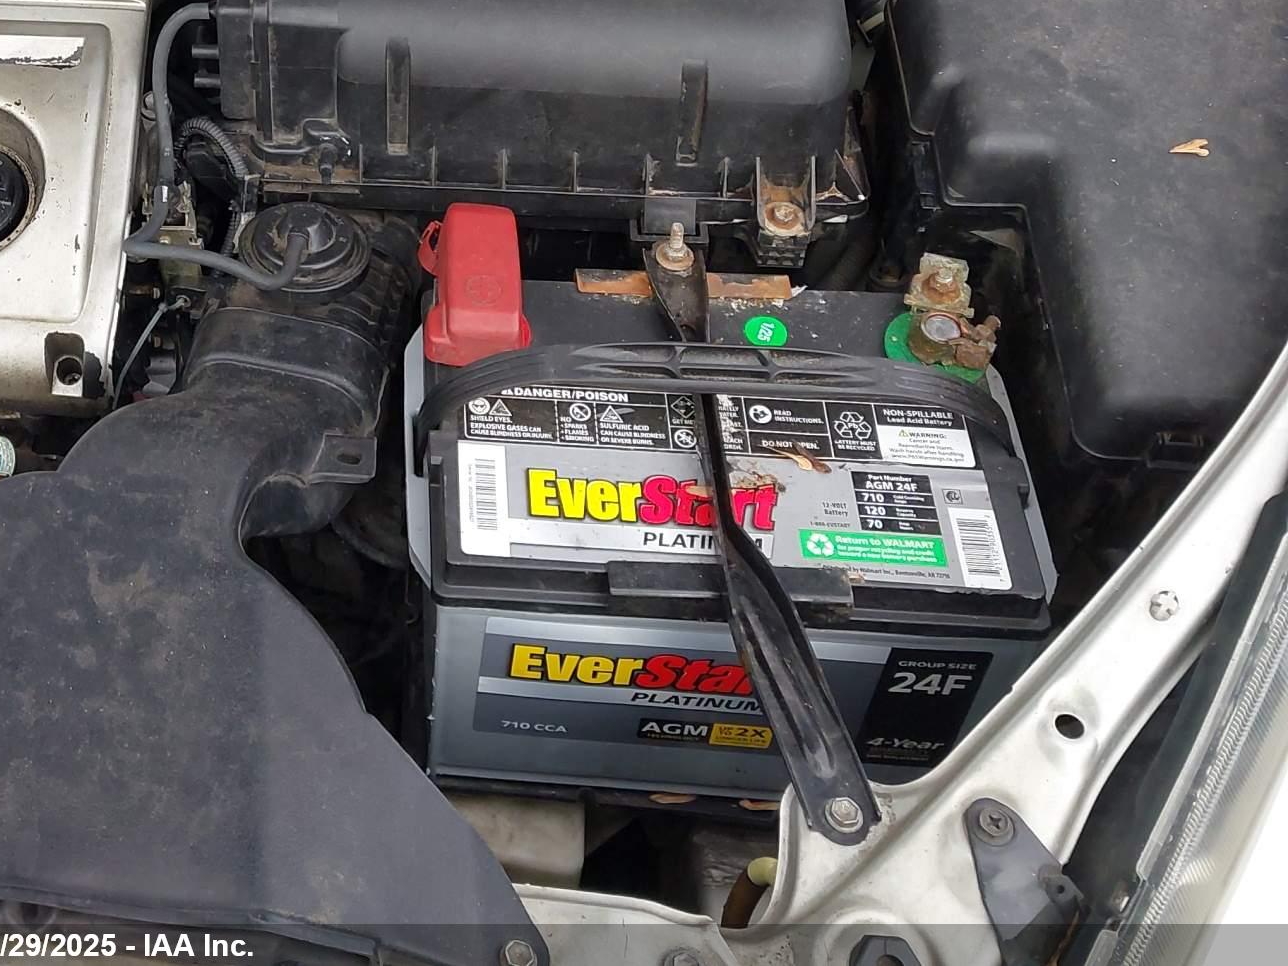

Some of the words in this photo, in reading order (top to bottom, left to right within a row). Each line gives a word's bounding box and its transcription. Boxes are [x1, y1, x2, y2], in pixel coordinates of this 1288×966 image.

[514, 387, 629, 402] DANGER/POISON
[883, 409, 954, 419] NON-SPILLABLE
[470, 423, 506, 431] EXPLOSIVE
[507, 424, 528, 432] GASES
[490, 430, 522, 438] BLINDNESS
[776, 440, 793, 448] NOT
[865, 482, 894, 491] AGM
[896, 483, 918, 492] 24F
[862, 493, 885, 502] 710
[824, 509, 848, 517] Battery
[864, 506, 886, 516] 120
[866, 519, 883, 529] 70
[835, 535, 868, 545] Return
[869, 537, 881, 546] to
[882, 538, 934, 549] WALMART
[898, 660, 946, 668] GROUP
[948, 662, 977, 670] SIZE
[887, 672, 973, 695] 24F
[501, 720, 530, 730] 710
[533, 723, 568, 733] CCA
[641, 721, 709, 737] AGM
[735, 727, 768, 738] 2X
[866, 737, 945, 750] 4-Year
